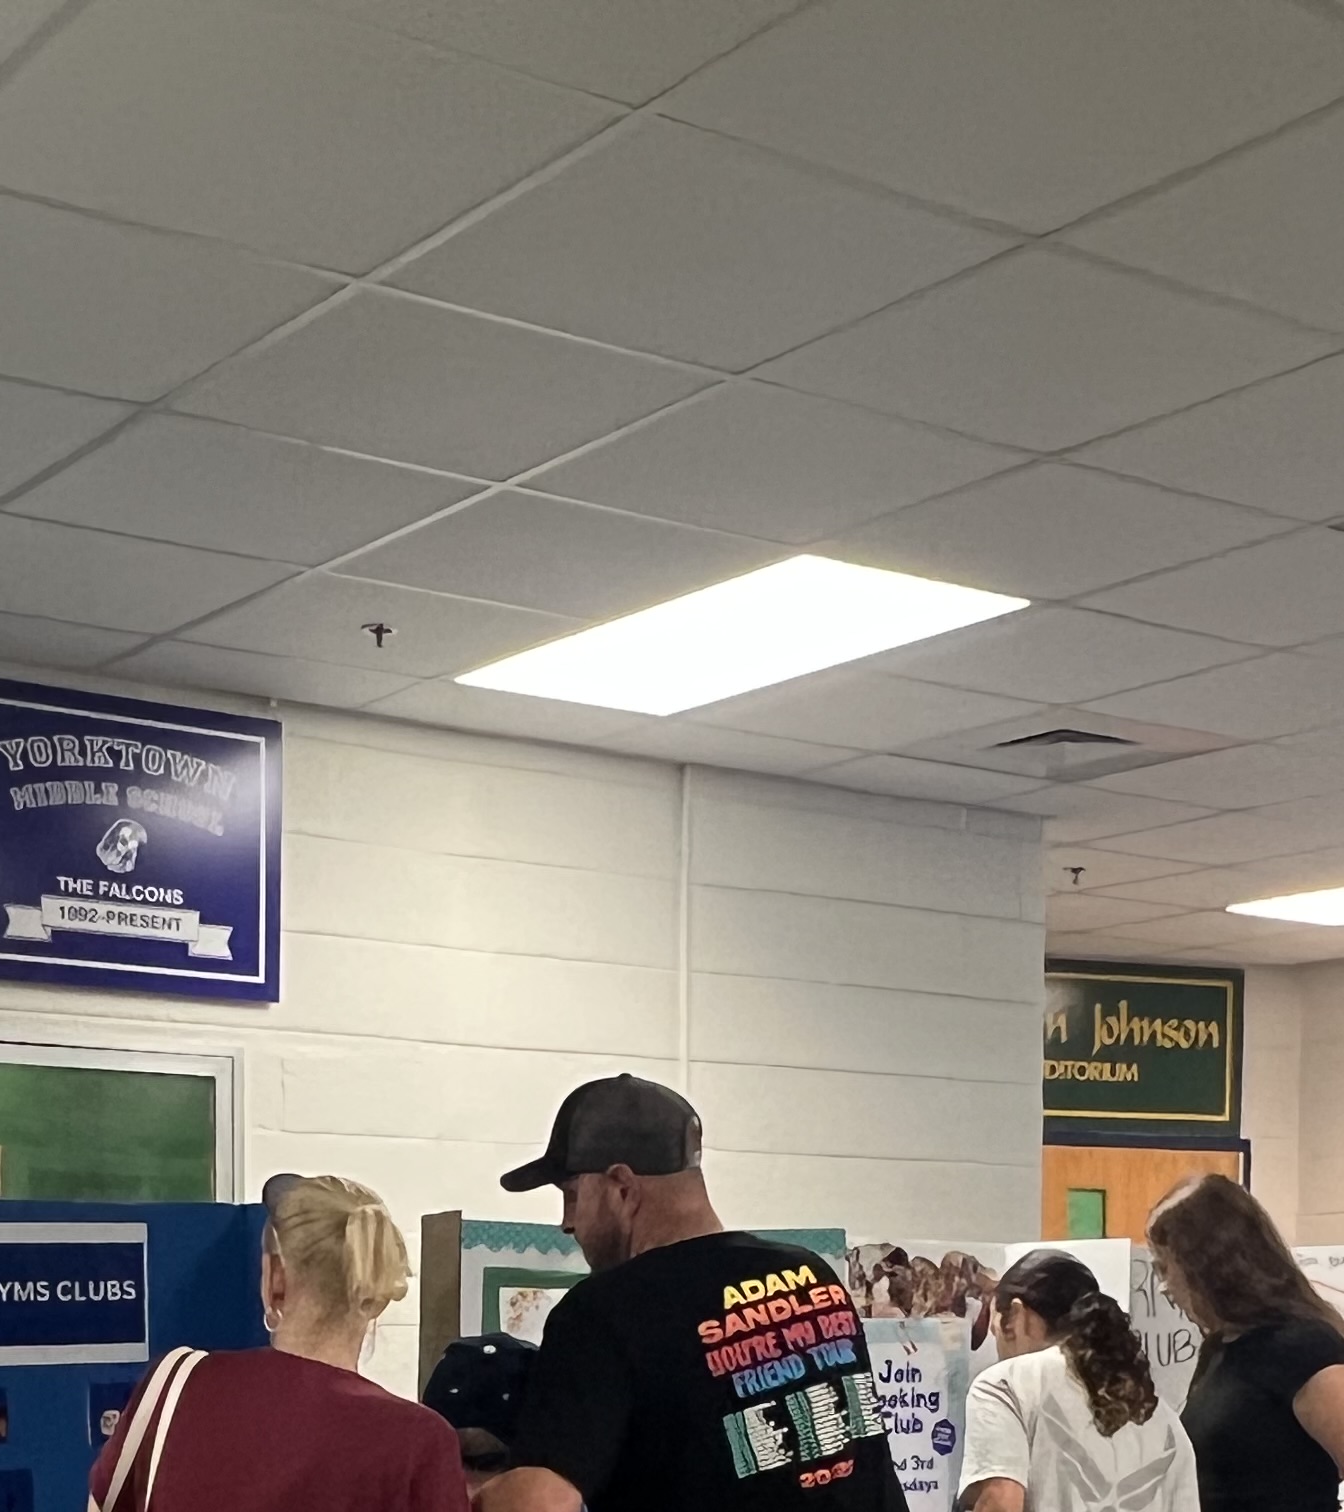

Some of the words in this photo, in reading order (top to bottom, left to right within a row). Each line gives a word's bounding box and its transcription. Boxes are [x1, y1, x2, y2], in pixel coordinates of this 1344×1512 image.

[10, 780, 119, 811] MIDDLE
[56, 876, 95, 896] THE
[98, 880, 185, 905] FALCONS
[1091, 999, 1220, 1057] Johnson
[1043, 1059, 1140, 1082] DITORIUM
[56, 1280, 137, 1302] CLUBS
[723, 1264, 818, 1310] ADAM
[697, 1284, 848, 1345] SANDLER
[1140, 1328, 1197, 1367] LUB
[731, 1353, 806, 1398] FRIEND
[878, 1358, 923, 1384] Join
[877, 1386, 941, 1414] ooking
